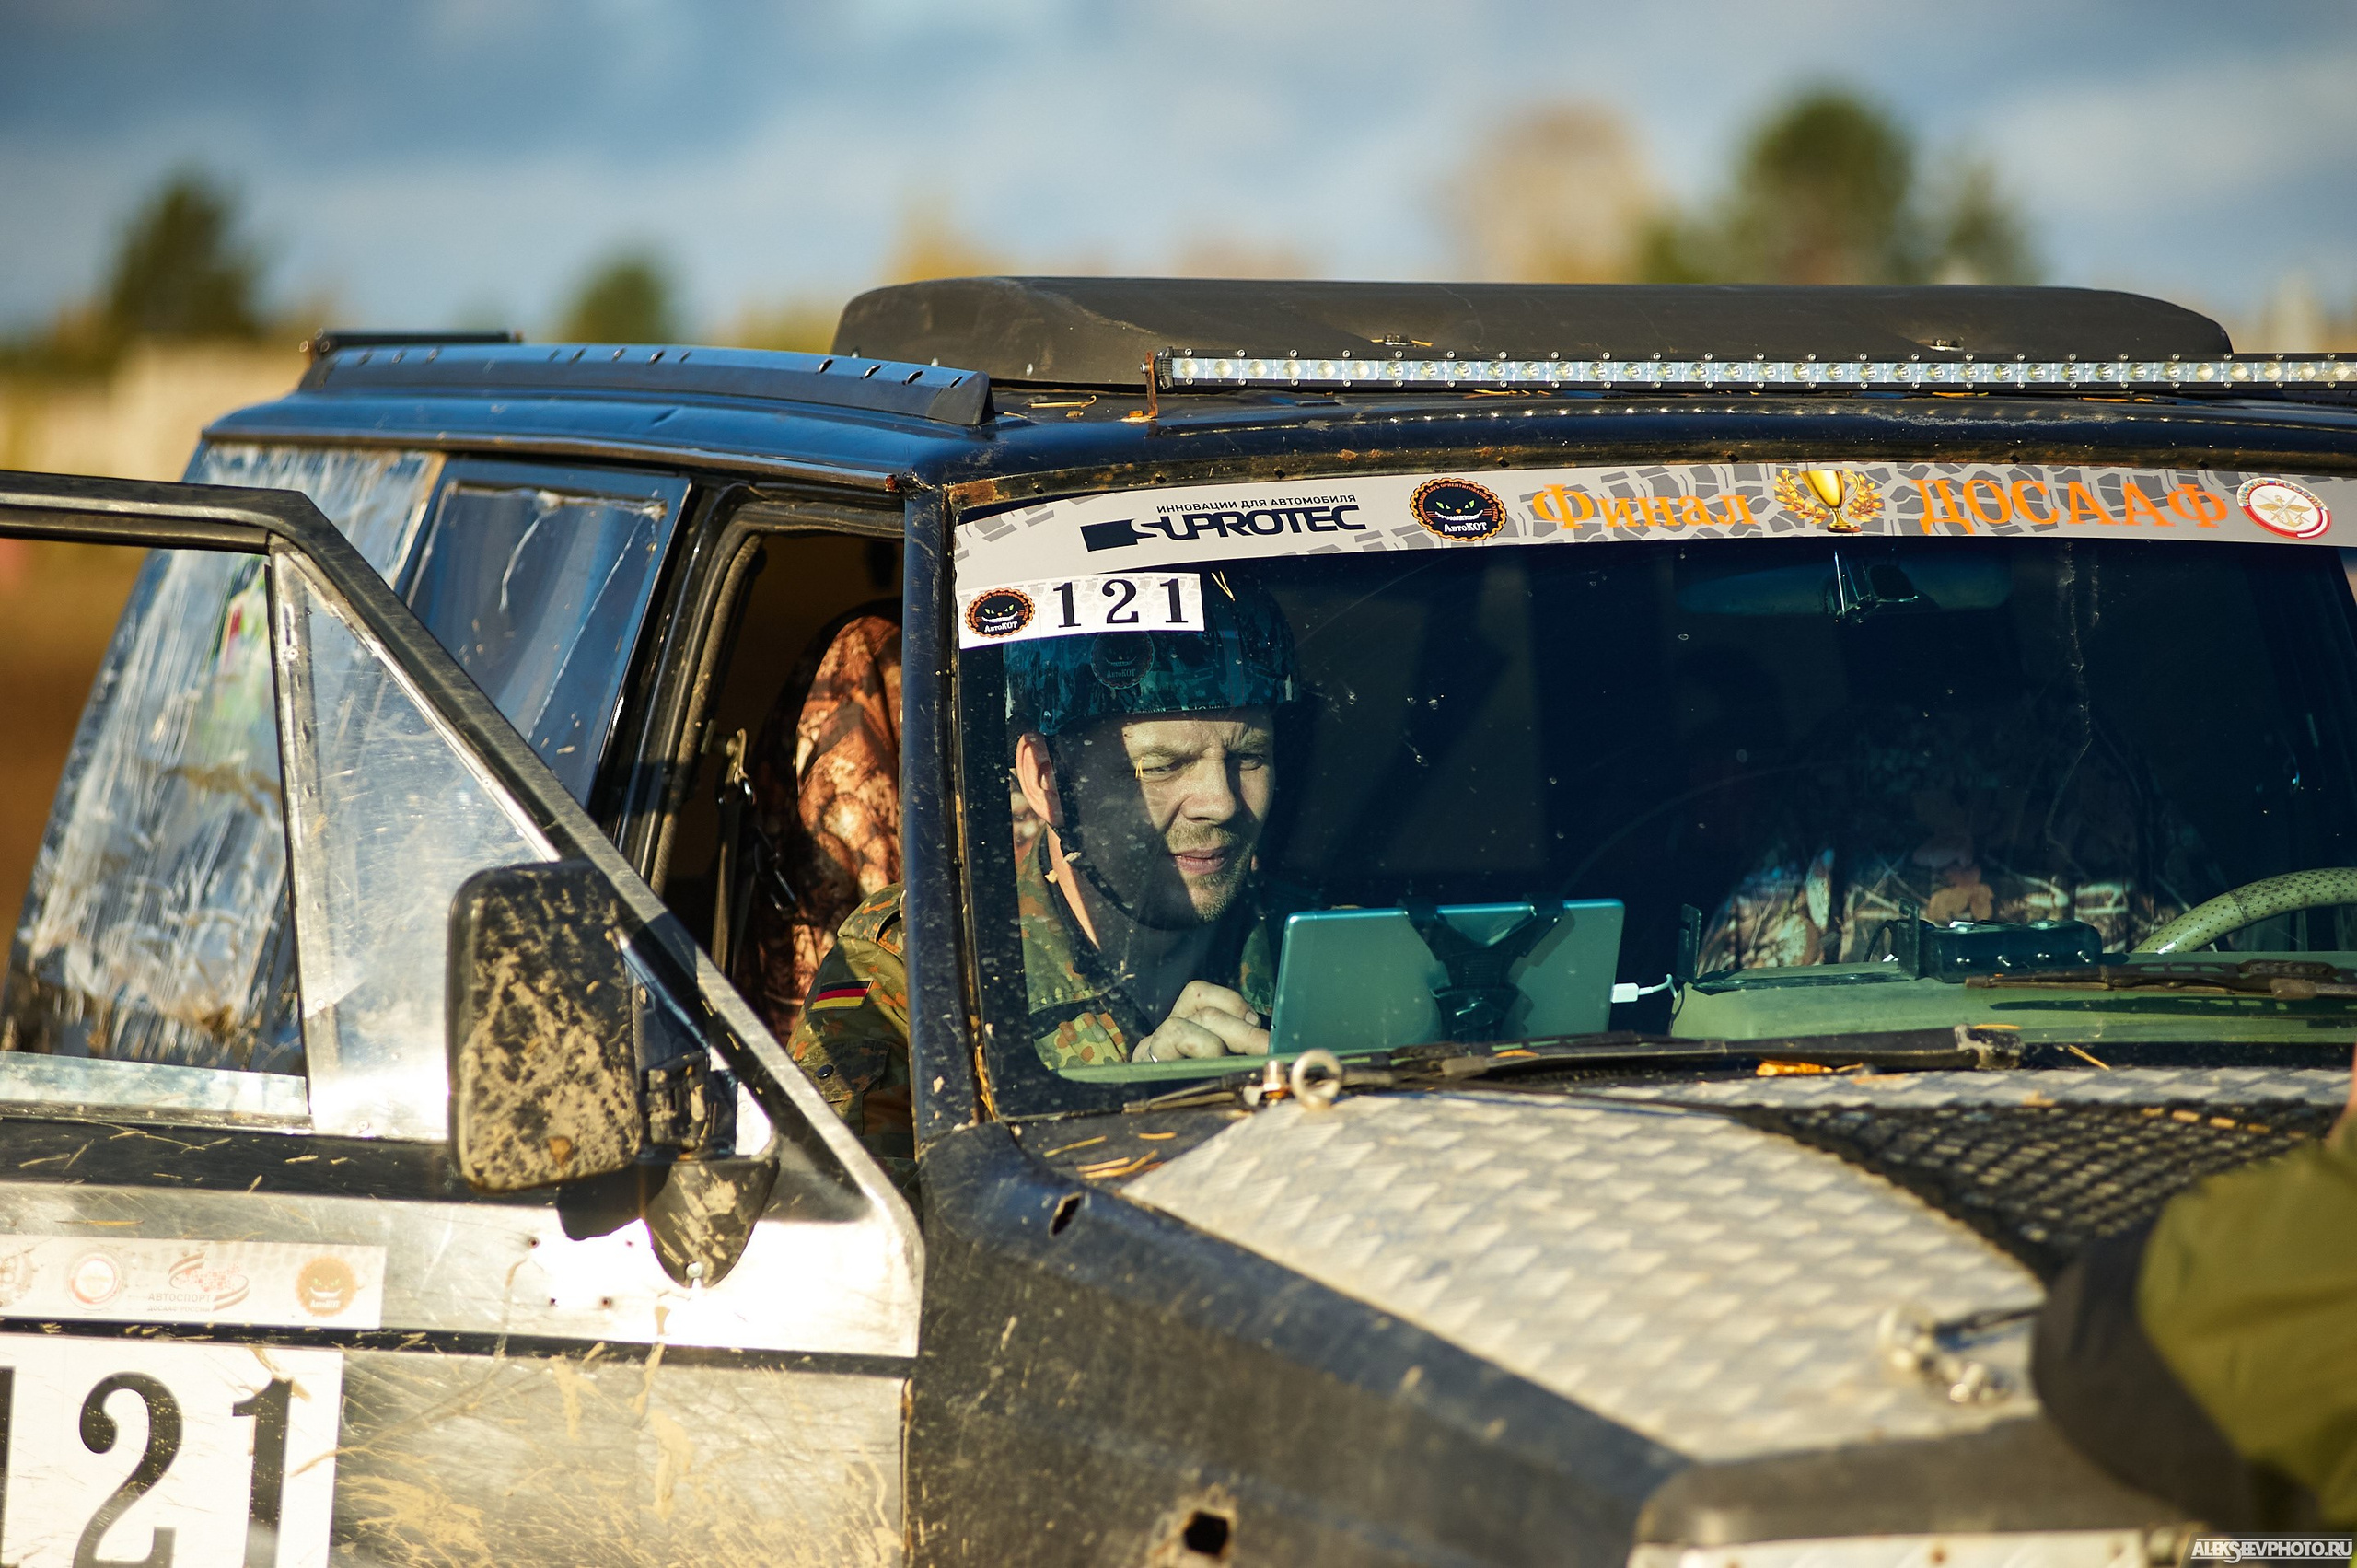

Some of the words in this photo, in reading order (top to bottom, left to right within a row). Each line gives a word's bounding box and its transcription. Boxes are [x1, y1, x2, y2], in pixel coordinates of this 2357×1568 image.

[1156, 500, 1237, 514] ИННОВАЦИИ
[1241, 499, 1267, 509] ДЛЯ
[1271, 494, 1357, 506] АВТОМОБИЛЯ
[1532, 483, 1758, 529] Финал
[1910, 479, 2228, 535] ДОСААФ
[1130, 505, 1367, 542] SUPROTEC
[1444, 522, 1488, 533] АвтоКОТ
[1052, 578, 1189, 628] 121
[984, 621, 1018, 633] АвтоКОТ
[147, 1292, 211, 1304] АВТОСПОРТ
